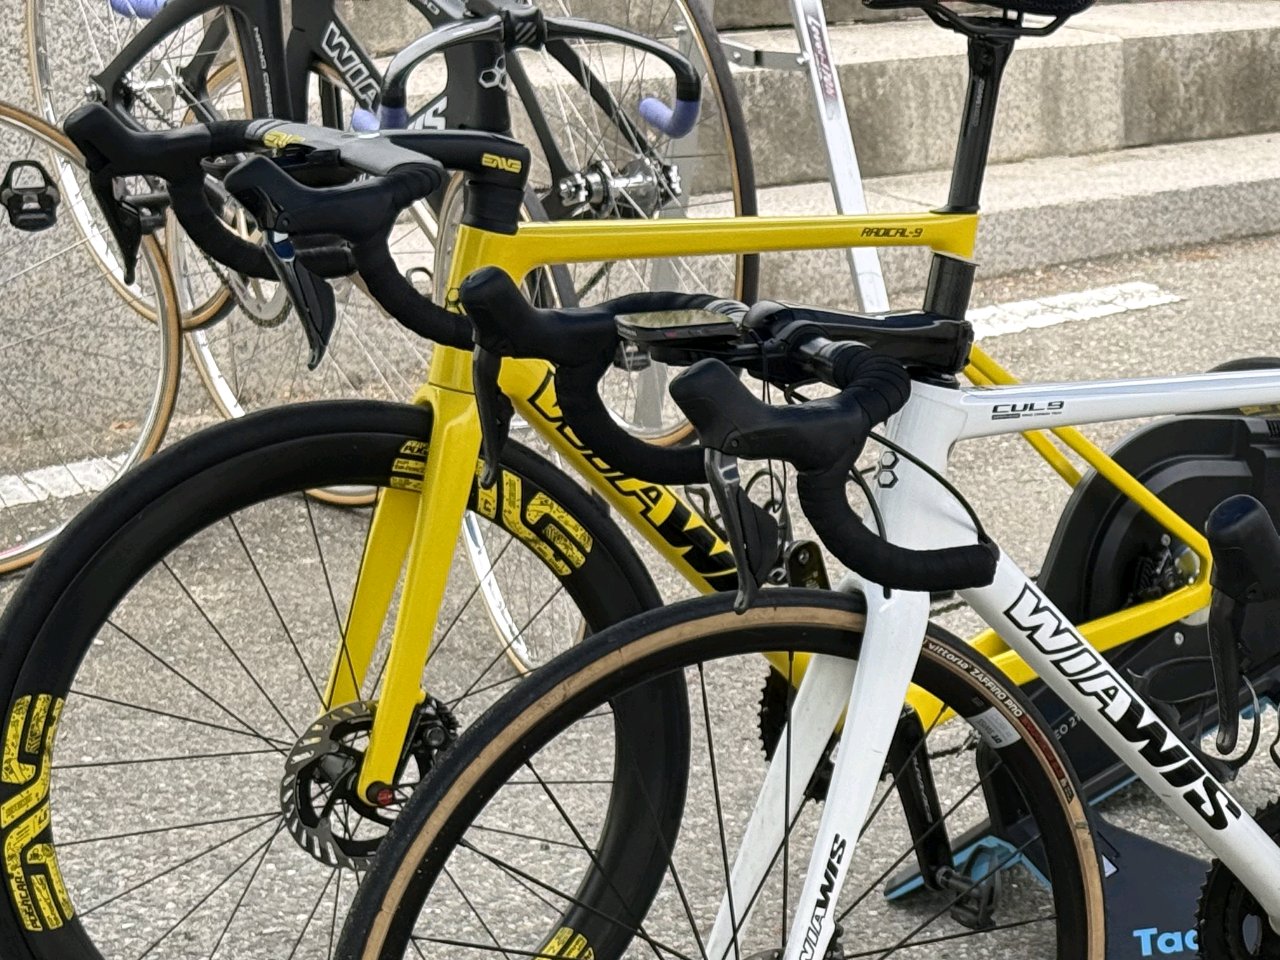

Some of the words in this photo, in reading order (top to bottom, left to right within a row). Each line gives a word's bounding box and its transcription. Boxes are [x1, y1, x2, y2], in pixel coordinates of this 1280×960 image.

[861, 227, 924, 238] RADICAL-9
[1003, 581, 1242, 831] WIAWIS
[1133, 927, 1199, 957] Tac
